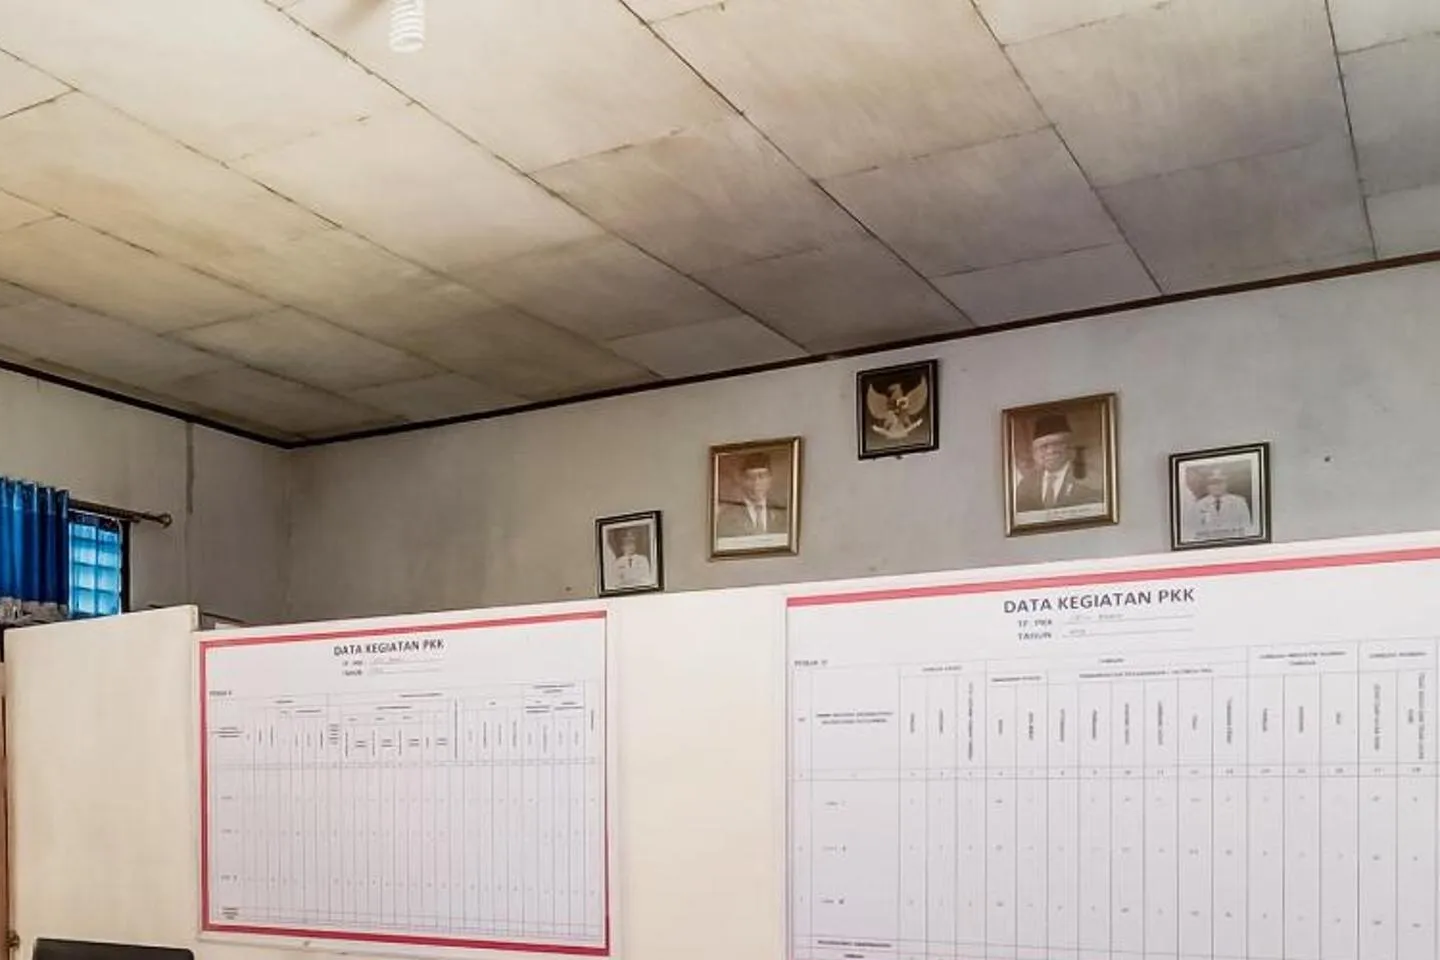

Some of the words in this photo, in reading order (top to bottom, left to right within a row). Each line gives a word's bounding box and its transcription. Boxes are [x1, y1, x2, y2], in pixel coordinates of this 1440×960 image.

[1003, 598, 1052, 614] DATA
[1058, 591, 1152, 610] KEGIATAN
[1158, 588, 1195, 604] PKK
[333, 644, 363, 657] DATA
[365, 640, 420, 654] KEGIATAN
[423, 638, 445, 650] PKK
